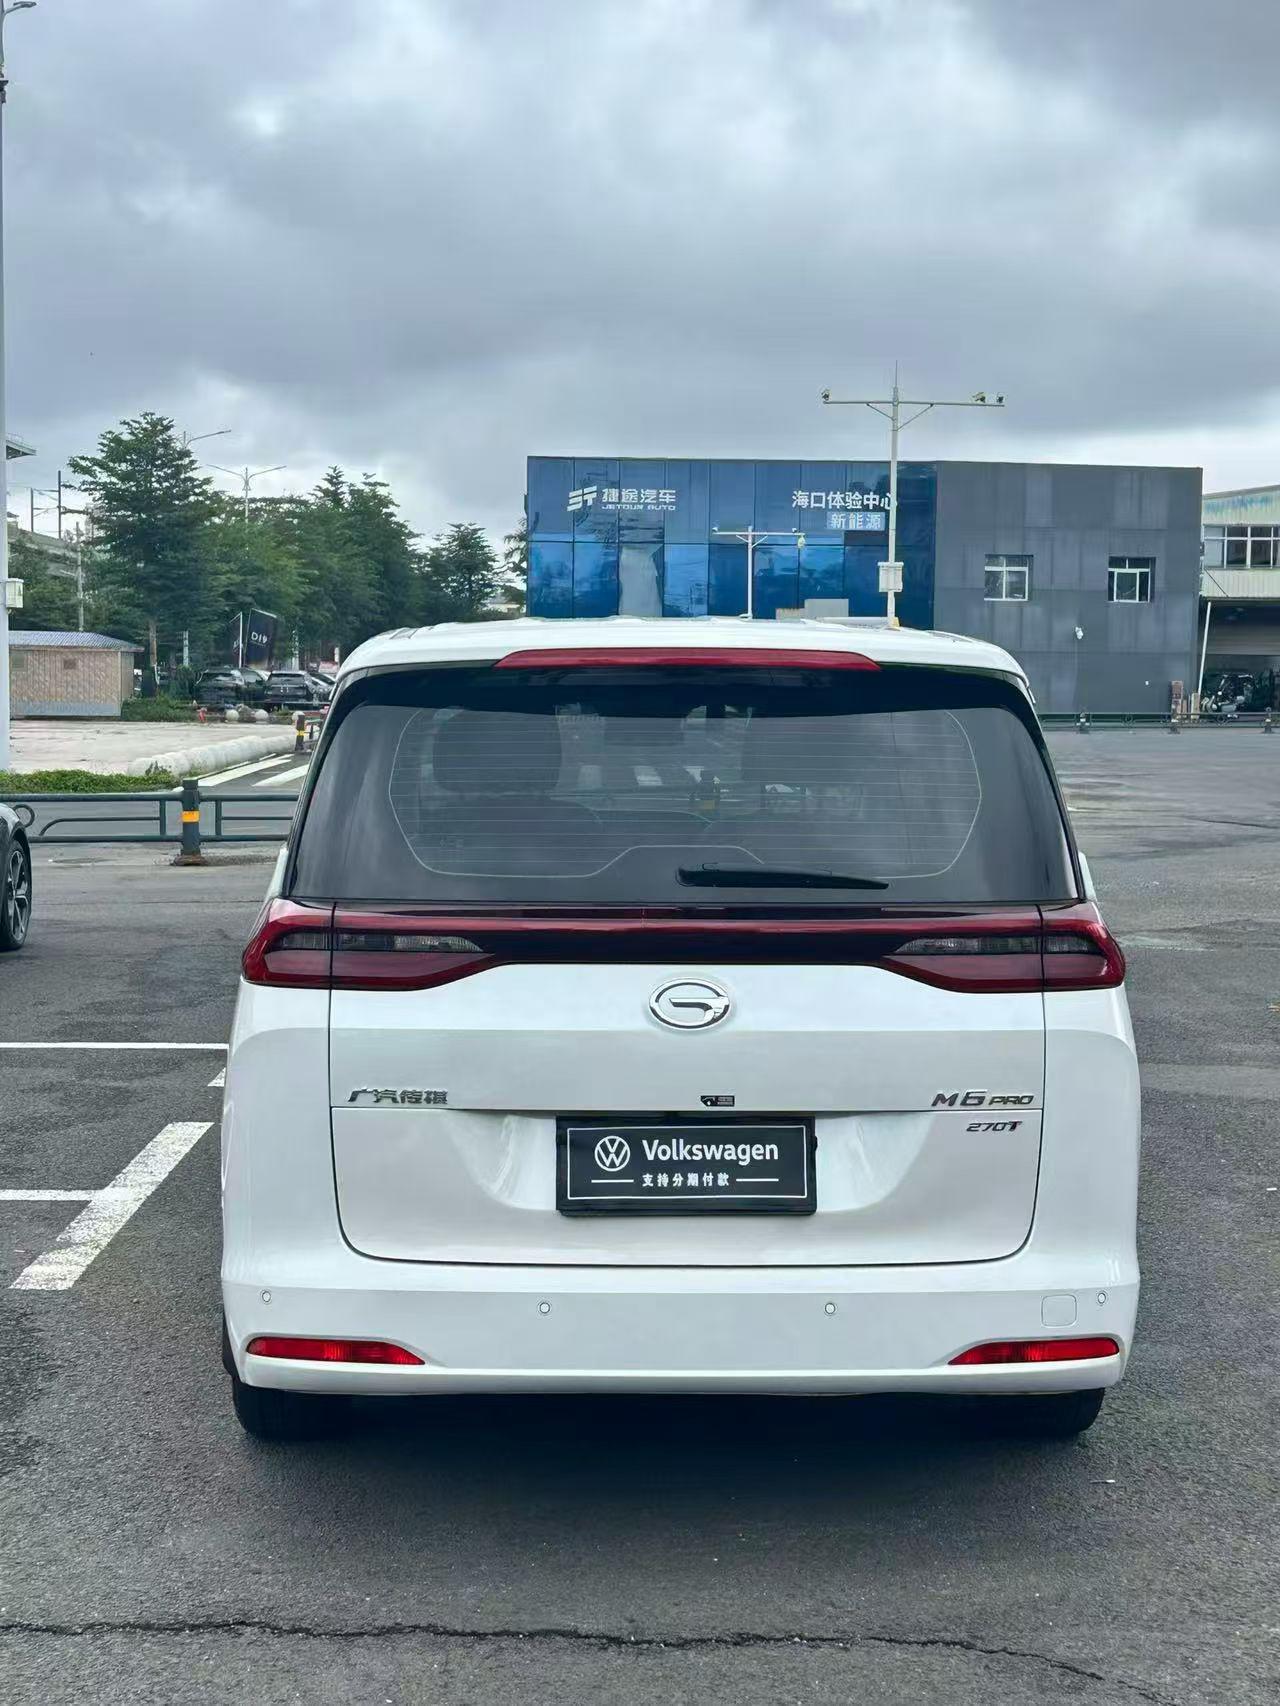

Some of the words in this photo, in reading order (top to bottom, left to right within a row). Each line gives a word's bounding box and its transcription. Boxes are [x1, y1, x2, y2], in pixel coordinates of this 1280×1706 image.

[602, 488, 676, 503] 捷途汽车
[792, 490, 898, 510] 海口体验中心
[831, 513, 881, 529] 新能源
[348, 1089, 448, 1104] 广汽传祺
[931, 1091, 987, 1107] M6
[988, 1095, 1034, 1106] PRO
[966, 1121, 1022, 1132] 270T
[642, 1138, 779, 1166] Volkswagen
[642, 1172, 730, 1187] 支持分期付款
